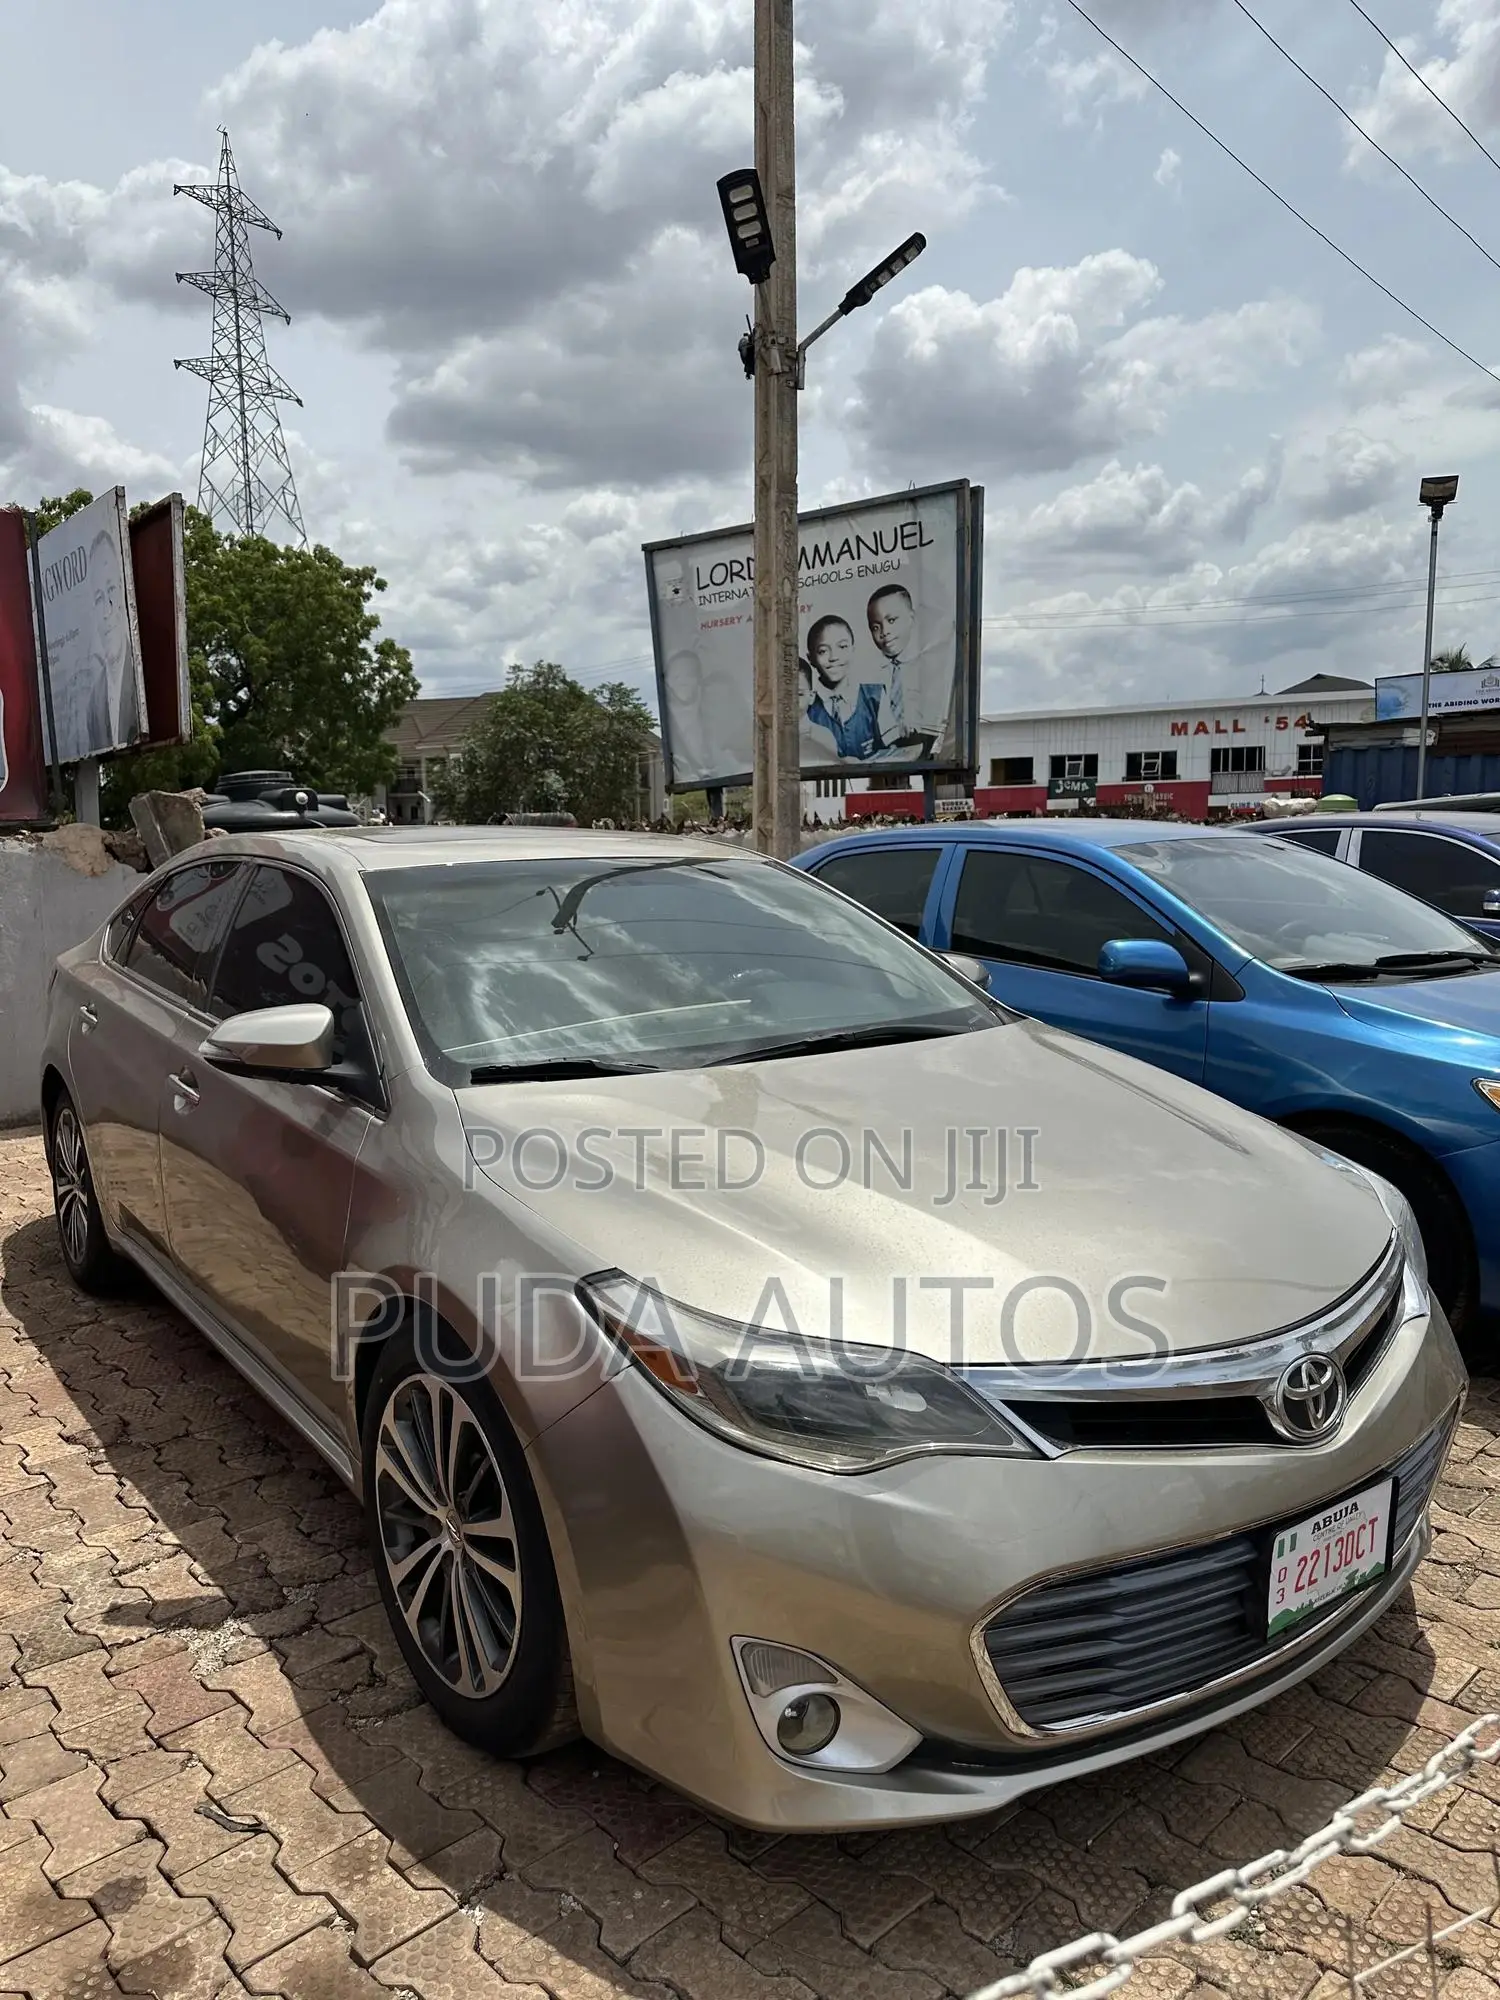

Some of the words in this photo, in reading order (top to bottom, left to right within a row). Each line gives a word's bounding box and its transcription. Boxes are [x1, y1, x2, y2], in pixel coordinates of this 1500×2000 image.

[797, 520, 934, 571] MMANUEL
[797, 568, 853, 589] SCHOOLS
[857, 558, 901, 578] ENUGU
[700, 615, 743, 630] NURSERY
[1171, 719, 1246, 736] MALL
[1311, 1501, 1359, 1535] ABUJA
[1294, 1516, 1379, 1594] 2213DCT
